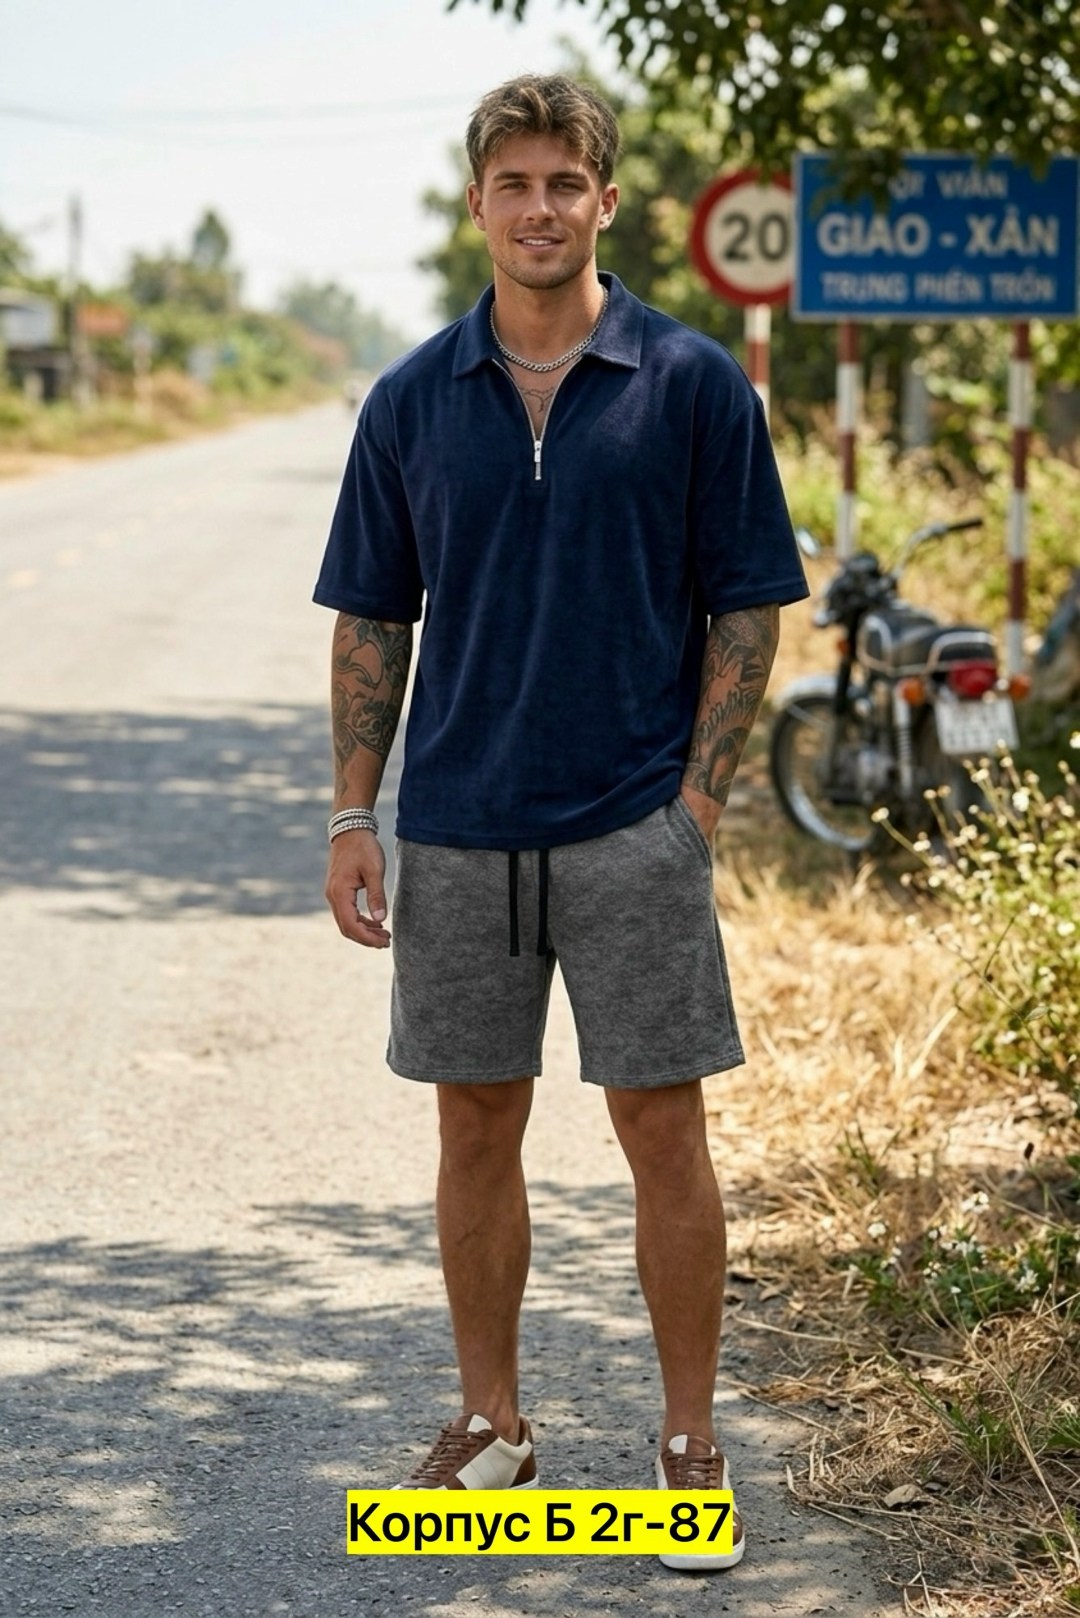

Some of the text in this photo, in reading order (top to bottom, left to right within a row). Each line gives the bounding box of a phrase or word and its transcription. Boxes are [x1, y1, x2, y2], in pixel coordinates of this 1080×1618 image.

[722, 212, 789, 263] 20
[817, 212, 931, 257] GIAO
[938, 232, 958, 247] -
